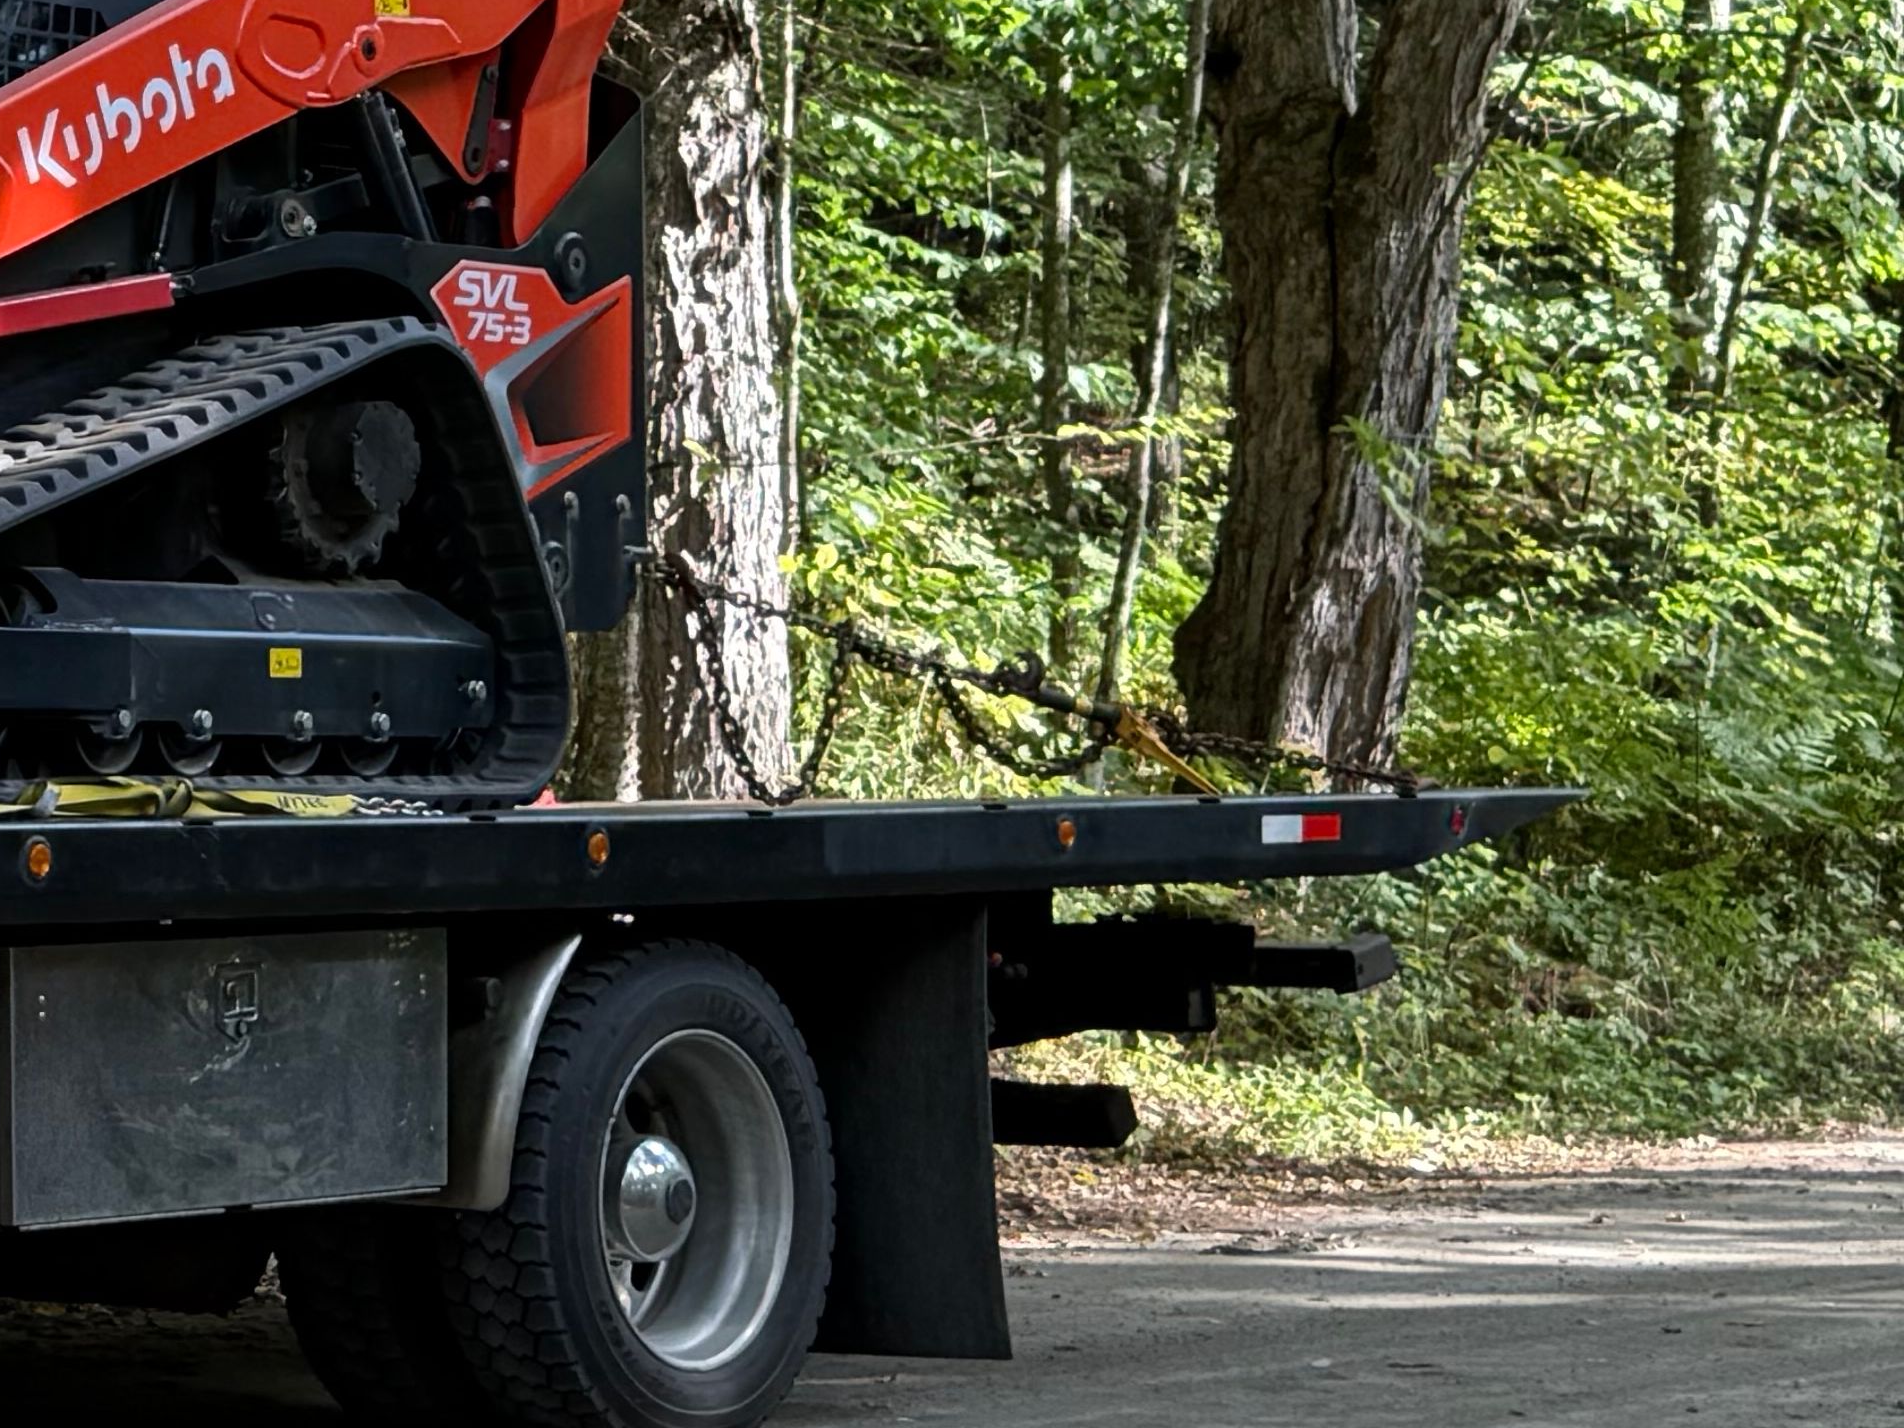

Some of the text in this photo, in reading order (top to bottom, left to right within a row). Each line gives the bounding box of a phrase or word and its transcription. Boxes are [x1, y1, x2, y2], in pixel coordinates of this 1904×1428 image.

[17, 43, 236, 188] Kubota
[453, 270, 529, 312] SVL
[467, 311, 532, 346] 75-3
